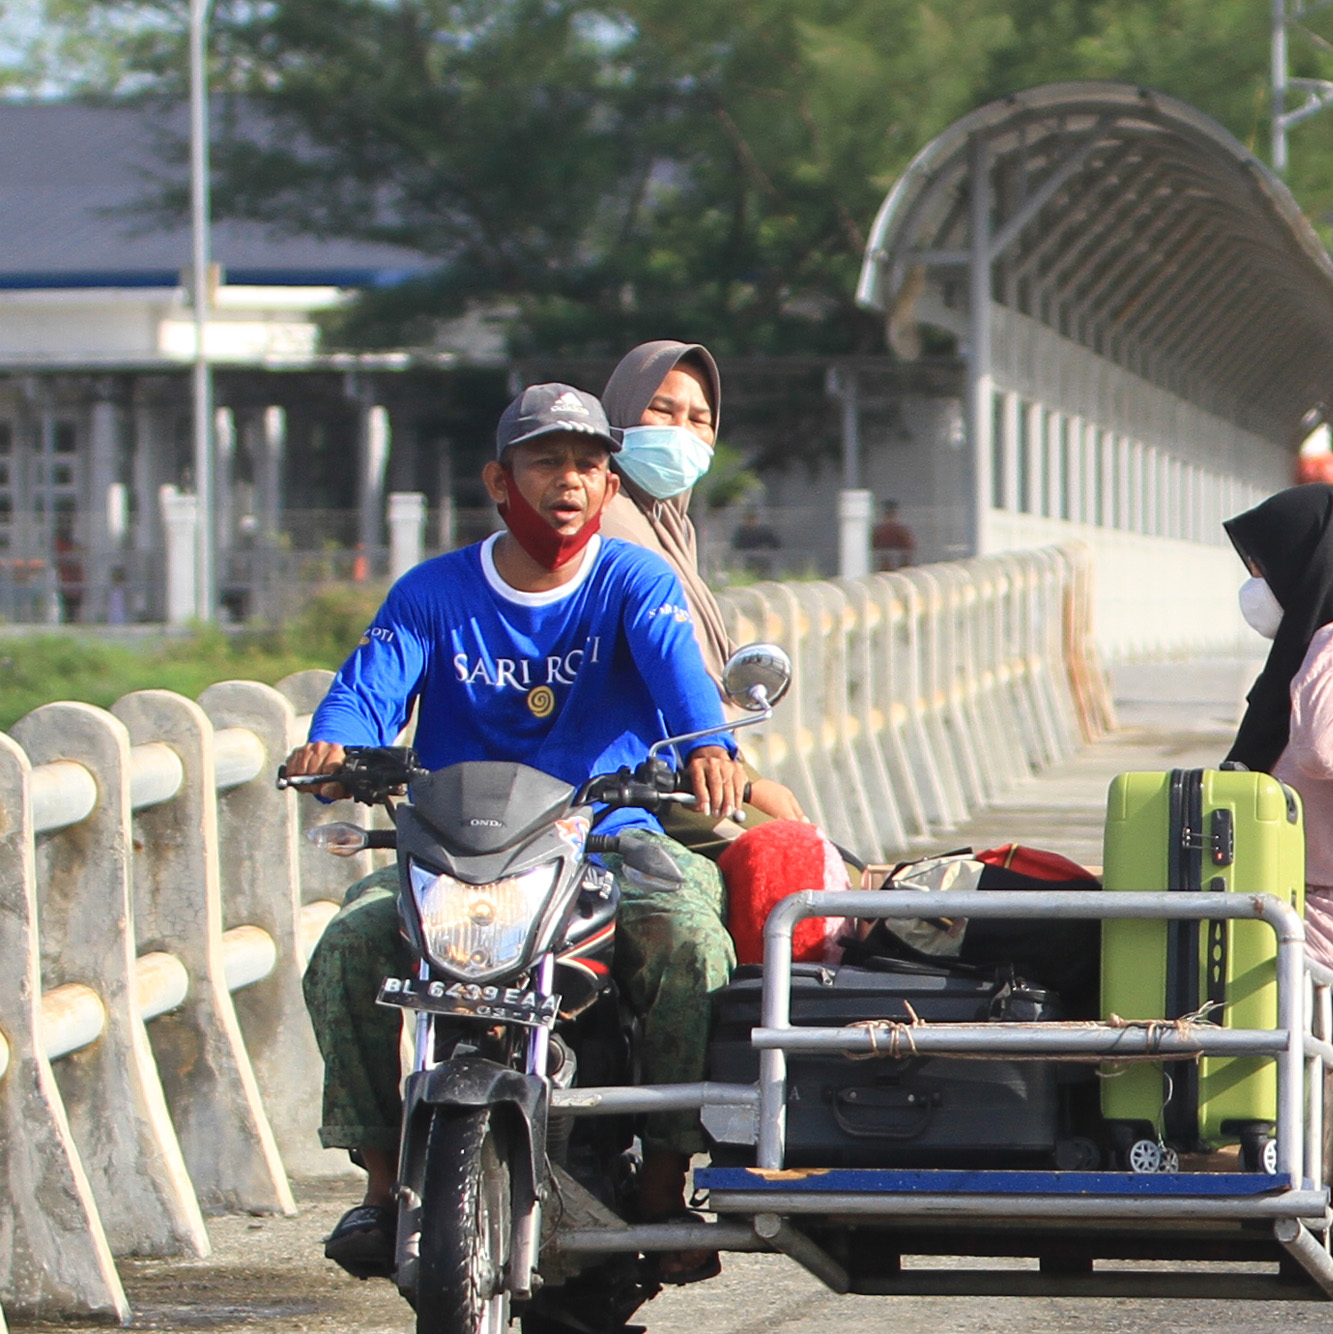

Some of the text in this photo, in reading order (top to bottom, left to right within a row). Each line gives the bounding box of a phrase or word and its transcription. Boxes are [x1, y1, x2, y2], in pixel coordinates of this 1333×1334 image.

[453, 636, 601, 691] SARI ROI
[385, 977, 417, 995] BL
[428, 981, 499, 1000] 6439
